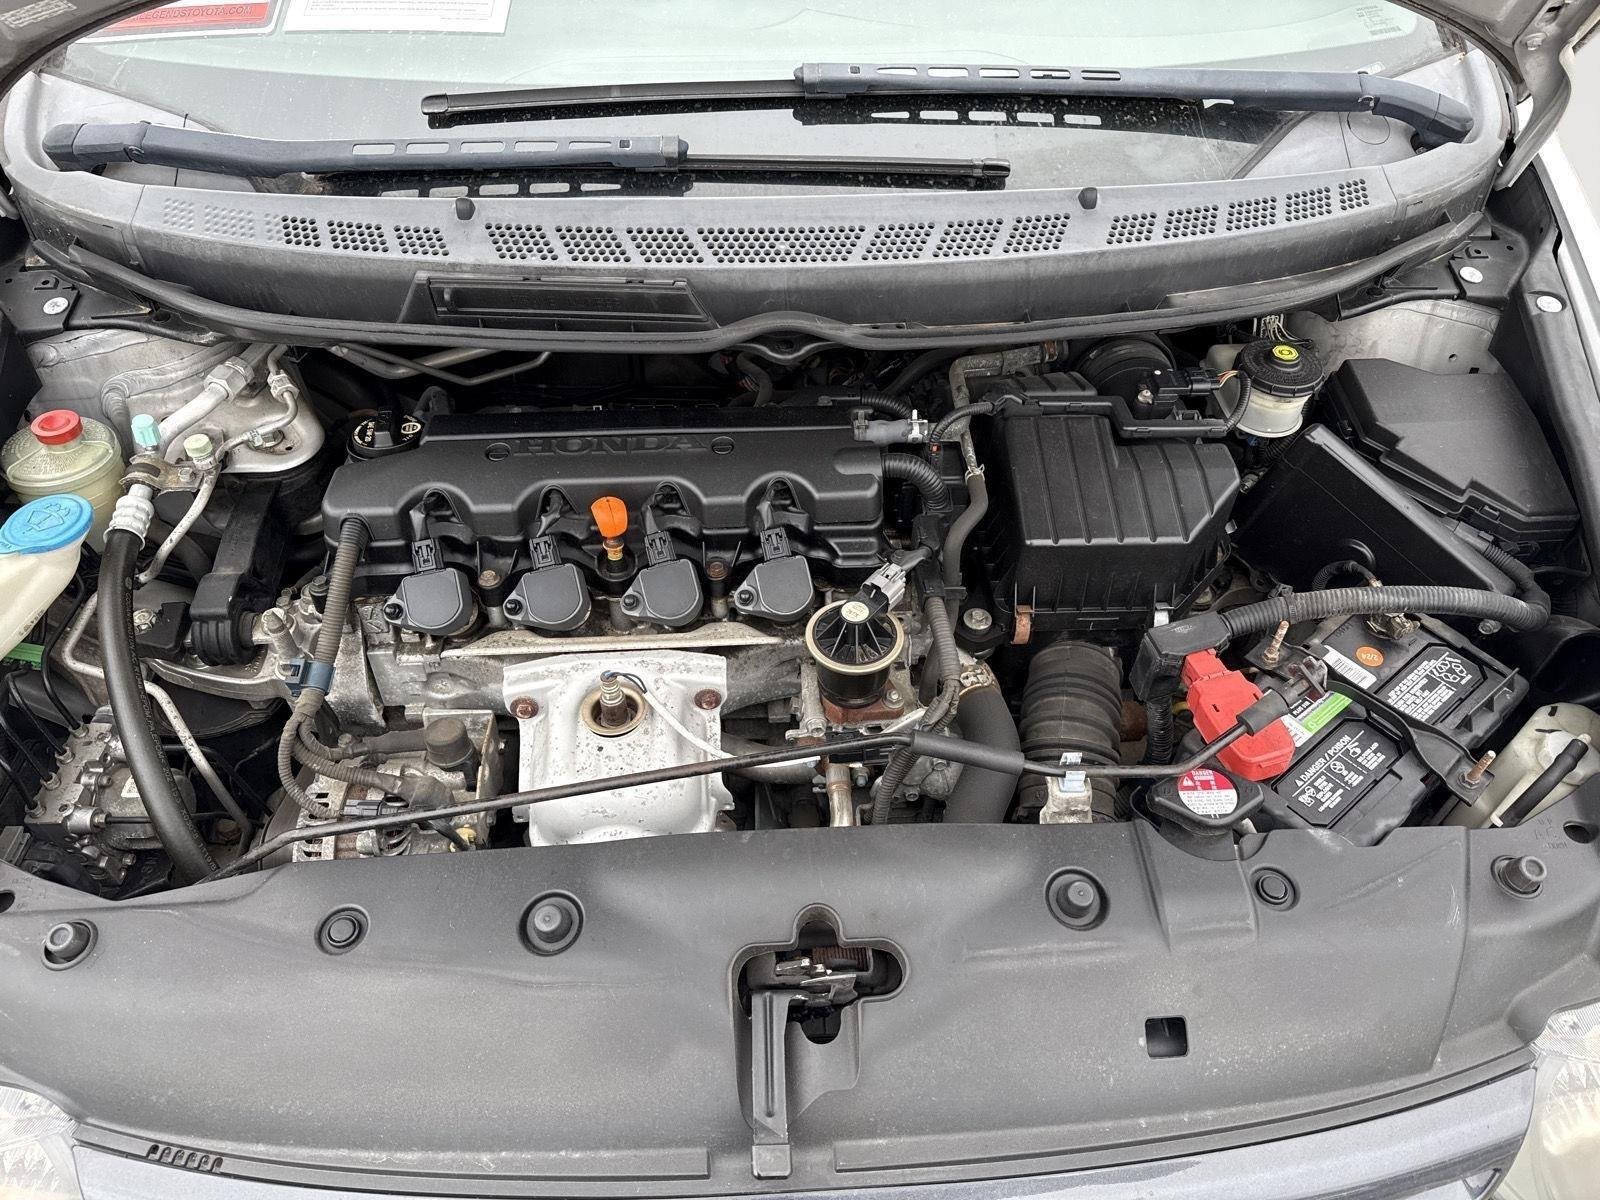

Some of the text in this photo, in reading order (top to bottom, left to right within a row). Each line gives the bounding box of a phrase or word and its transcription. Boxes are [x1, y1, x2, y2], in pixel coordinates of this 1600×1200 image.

[134, 6, 252, 21] LEGENDSTOYOTA.COM
[513, 436, 707, 455] HONDA
[1300, 757, 1327, 781] DANGER
[1327, 734, 1352, 756] POISON
